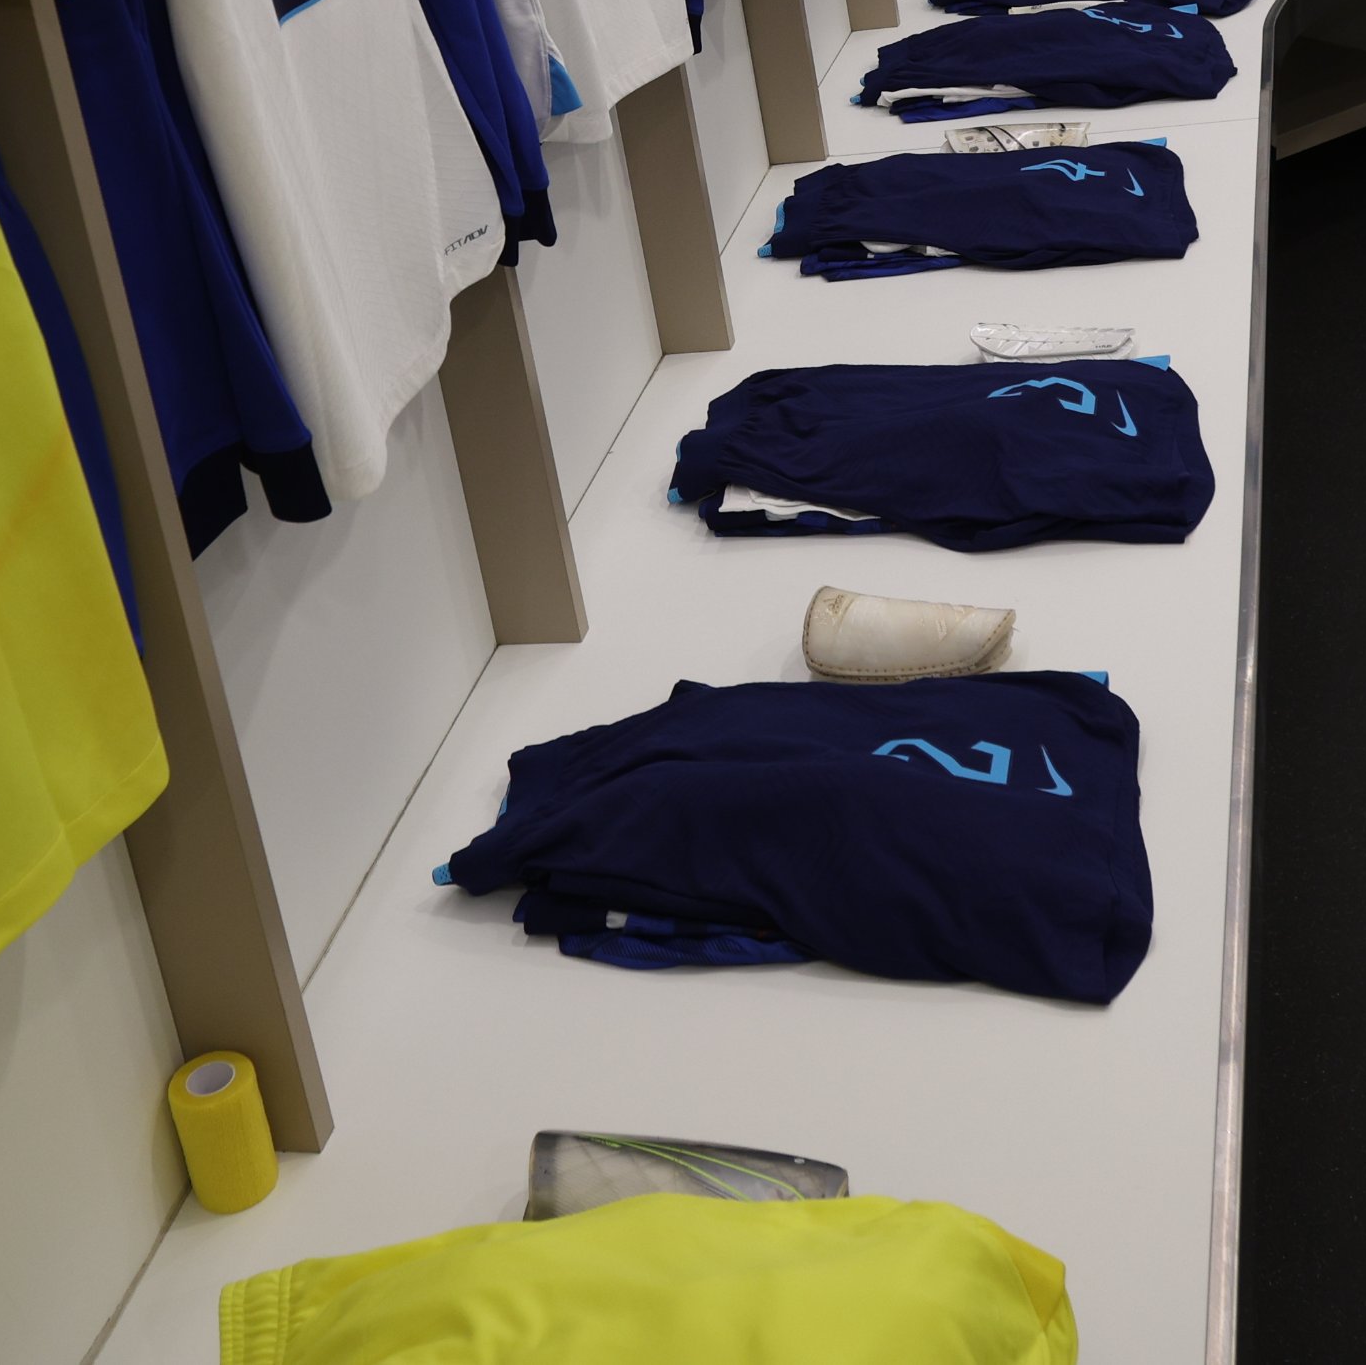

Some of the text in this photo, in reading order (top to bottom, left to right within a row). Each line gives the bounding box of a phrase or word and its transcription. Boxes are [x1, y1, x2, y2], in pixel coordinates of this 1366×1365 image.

[1082, 8, 1152, 33] 5
[1020, 159, 1105, 182] 4
[987, 376, 1096, 415] 3
[871, 738, 1012, 785] 2
